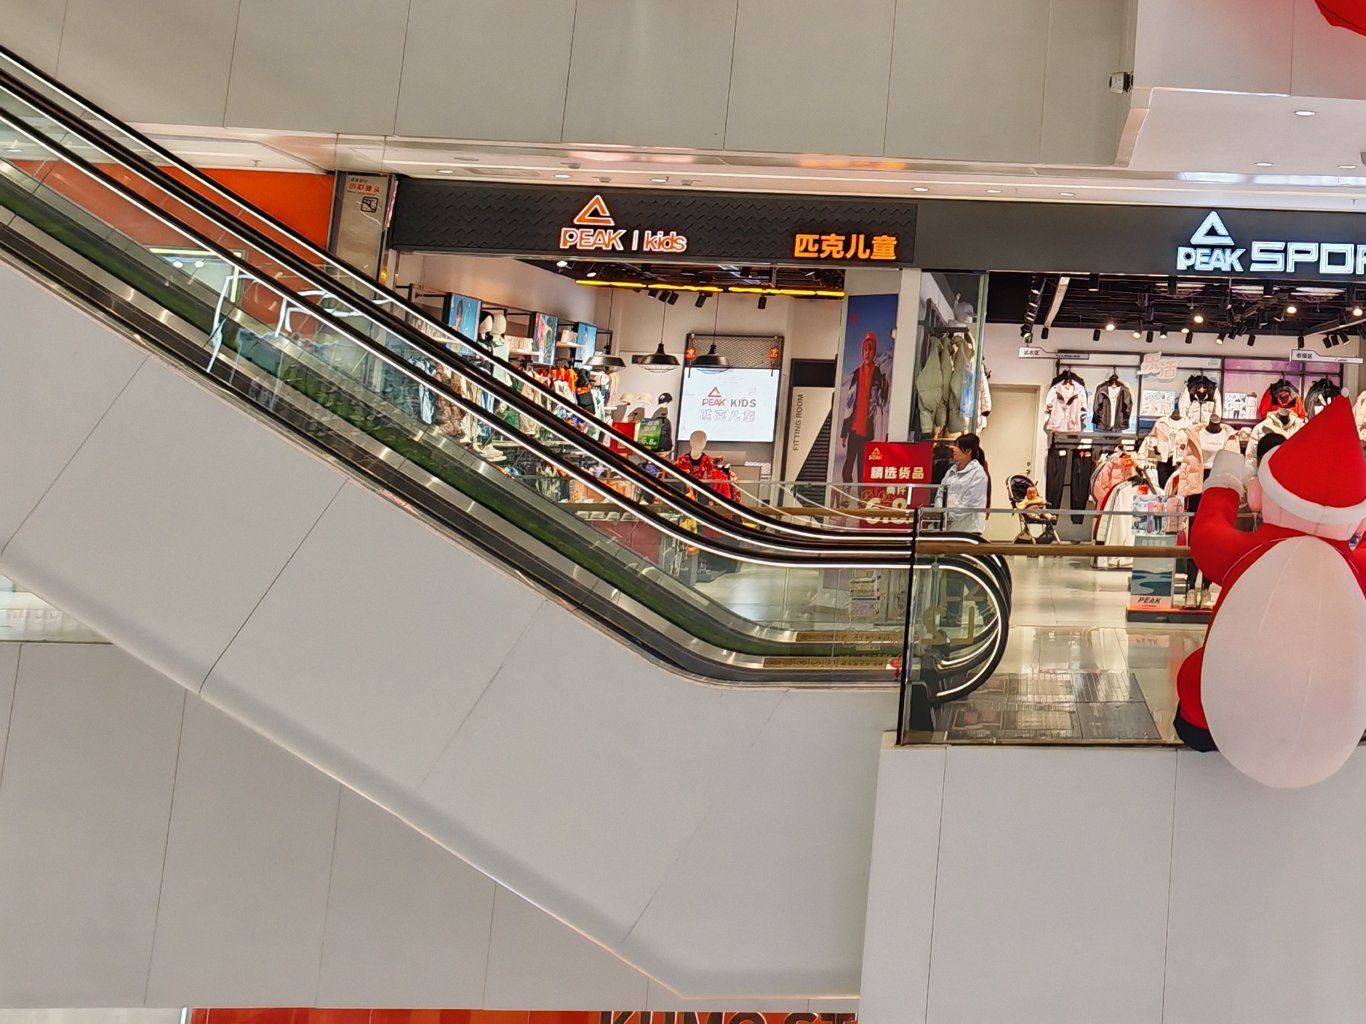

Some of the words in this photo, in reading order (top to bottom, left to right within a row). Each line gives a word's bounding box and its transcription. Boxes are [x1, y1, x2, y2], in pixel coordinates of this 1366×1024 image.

[560, 228, 627, 251] PEAK
[643, 231, 688, 254] kids
[794, 233, 898, 260] 匹克儿童
[1176, 245, 1247, 273] PEAK
[702, 398, 726, 407] PEAK
[730, 399, 757, 408] KIDS
[793, 418, 802, 451] FITTING
